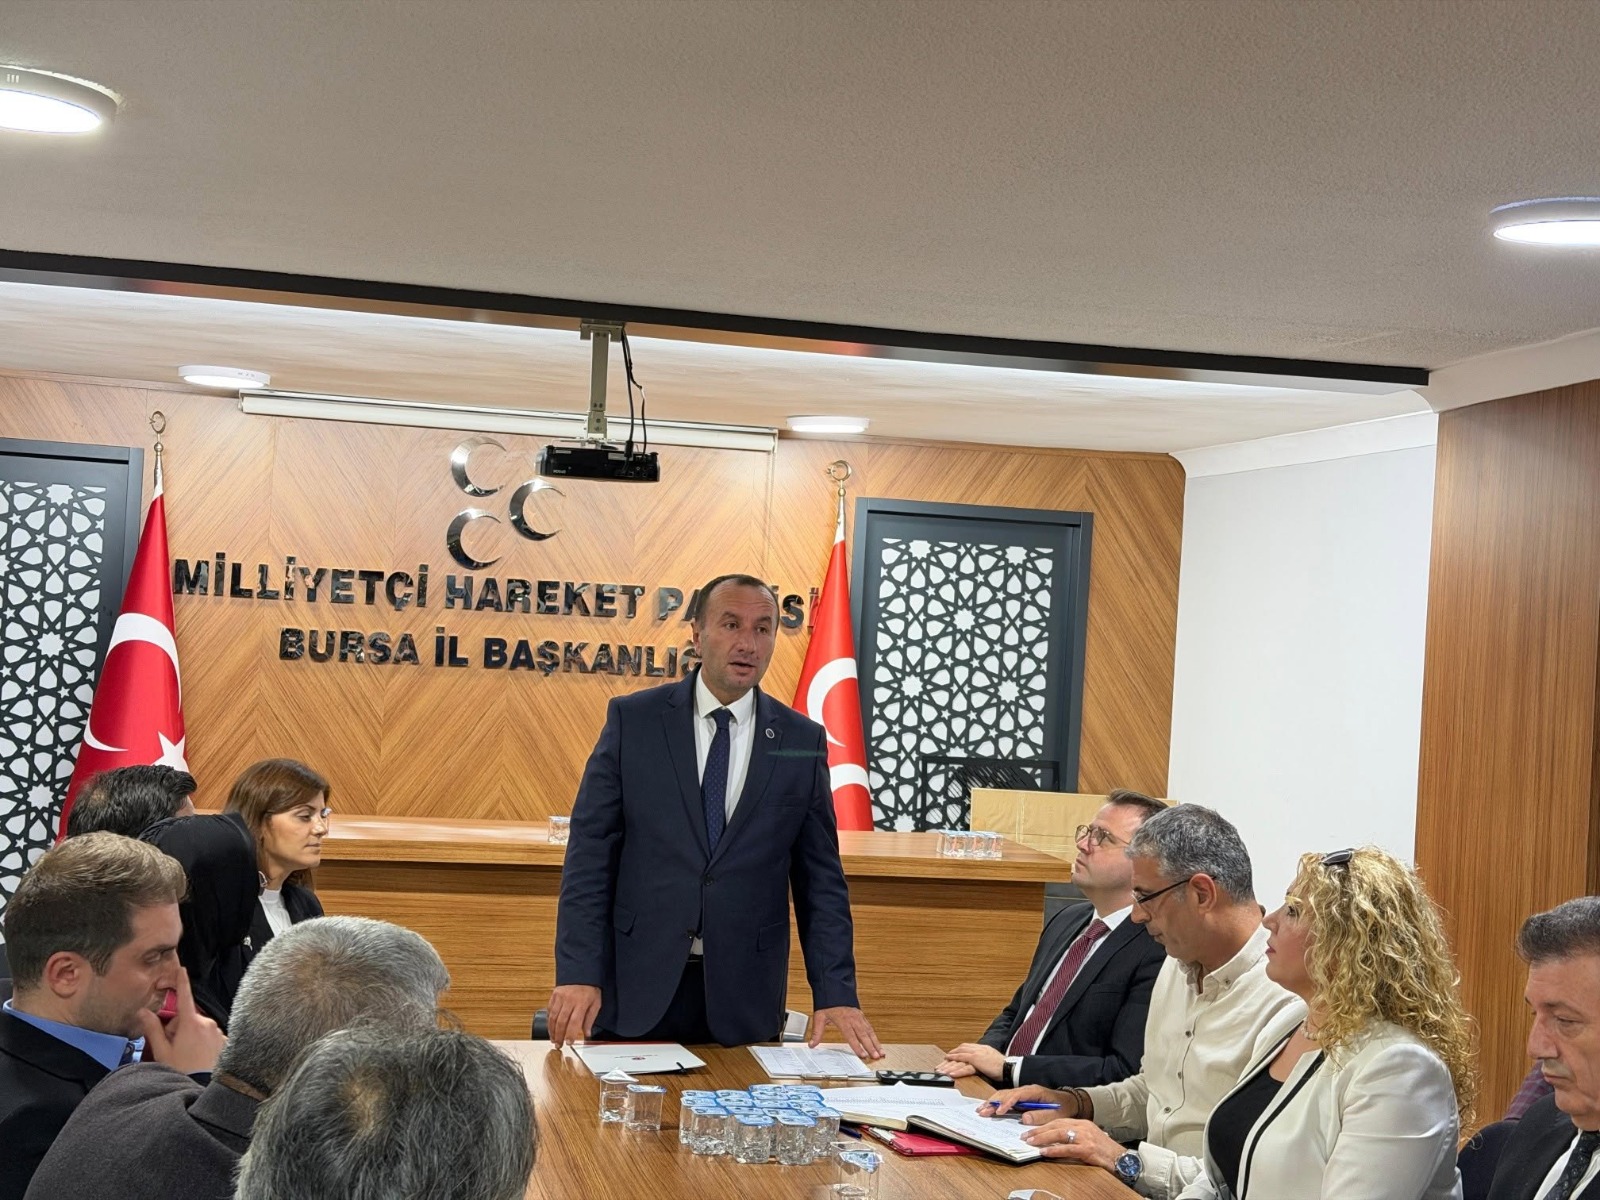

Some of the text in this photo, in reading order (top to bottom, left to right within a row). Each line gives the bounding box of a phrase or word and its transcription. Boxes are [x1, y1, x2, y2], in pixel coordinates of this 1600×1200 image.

[173, 552, 819, 629] MİLLİYETÇİ HAREKET PASİ
[279, 626, 702, 677] BURSA İL BAŞKANLIĞ
